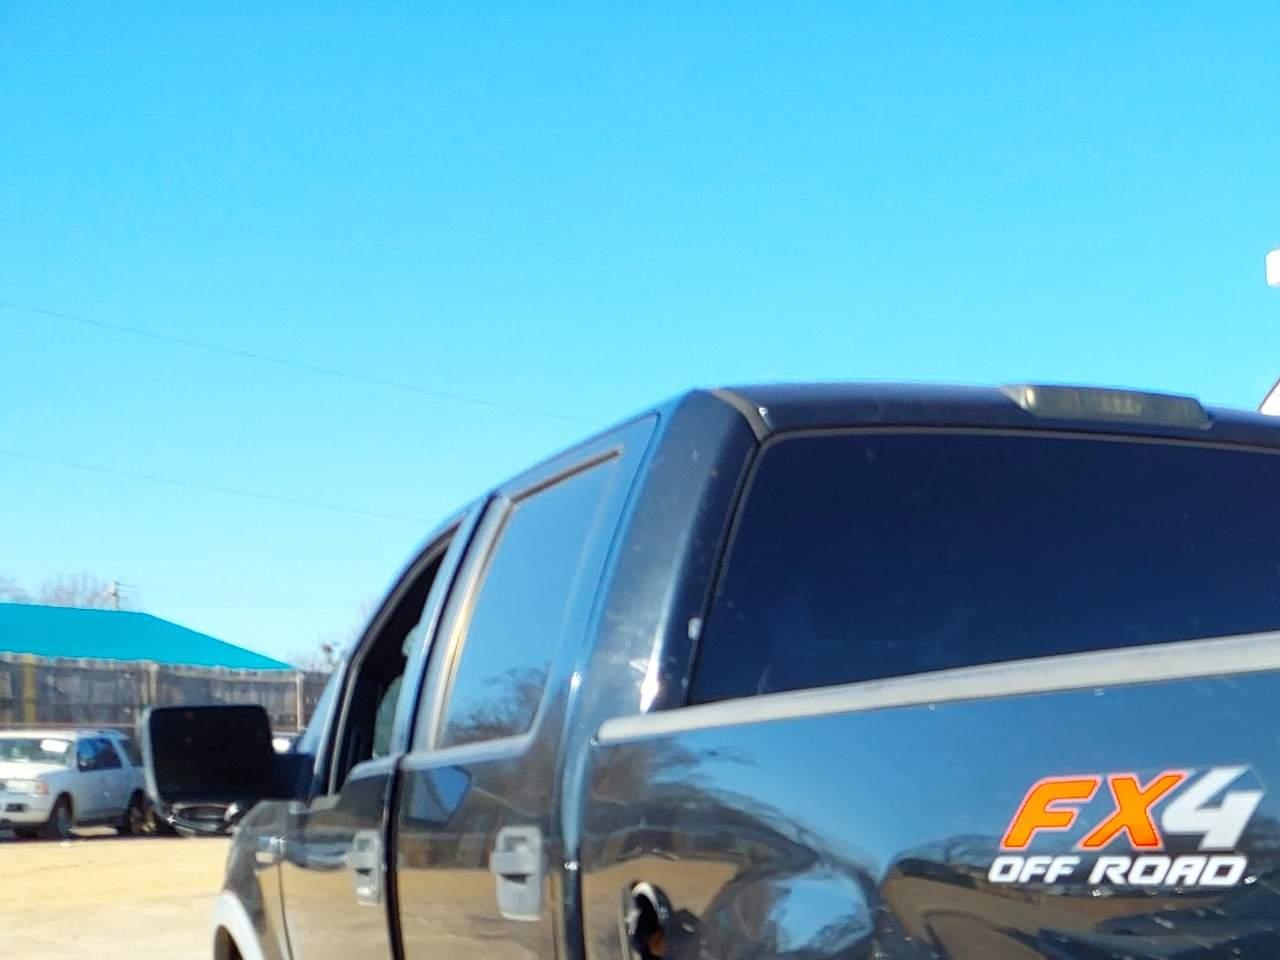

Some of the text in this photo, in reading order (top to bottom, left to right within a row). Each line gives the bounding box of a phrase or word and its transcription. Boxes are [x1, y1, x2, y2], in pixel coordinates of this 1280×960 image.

[1000, 763, 1265, 852] FX4
[987, 855, 1248, 887] OFF ROAD
